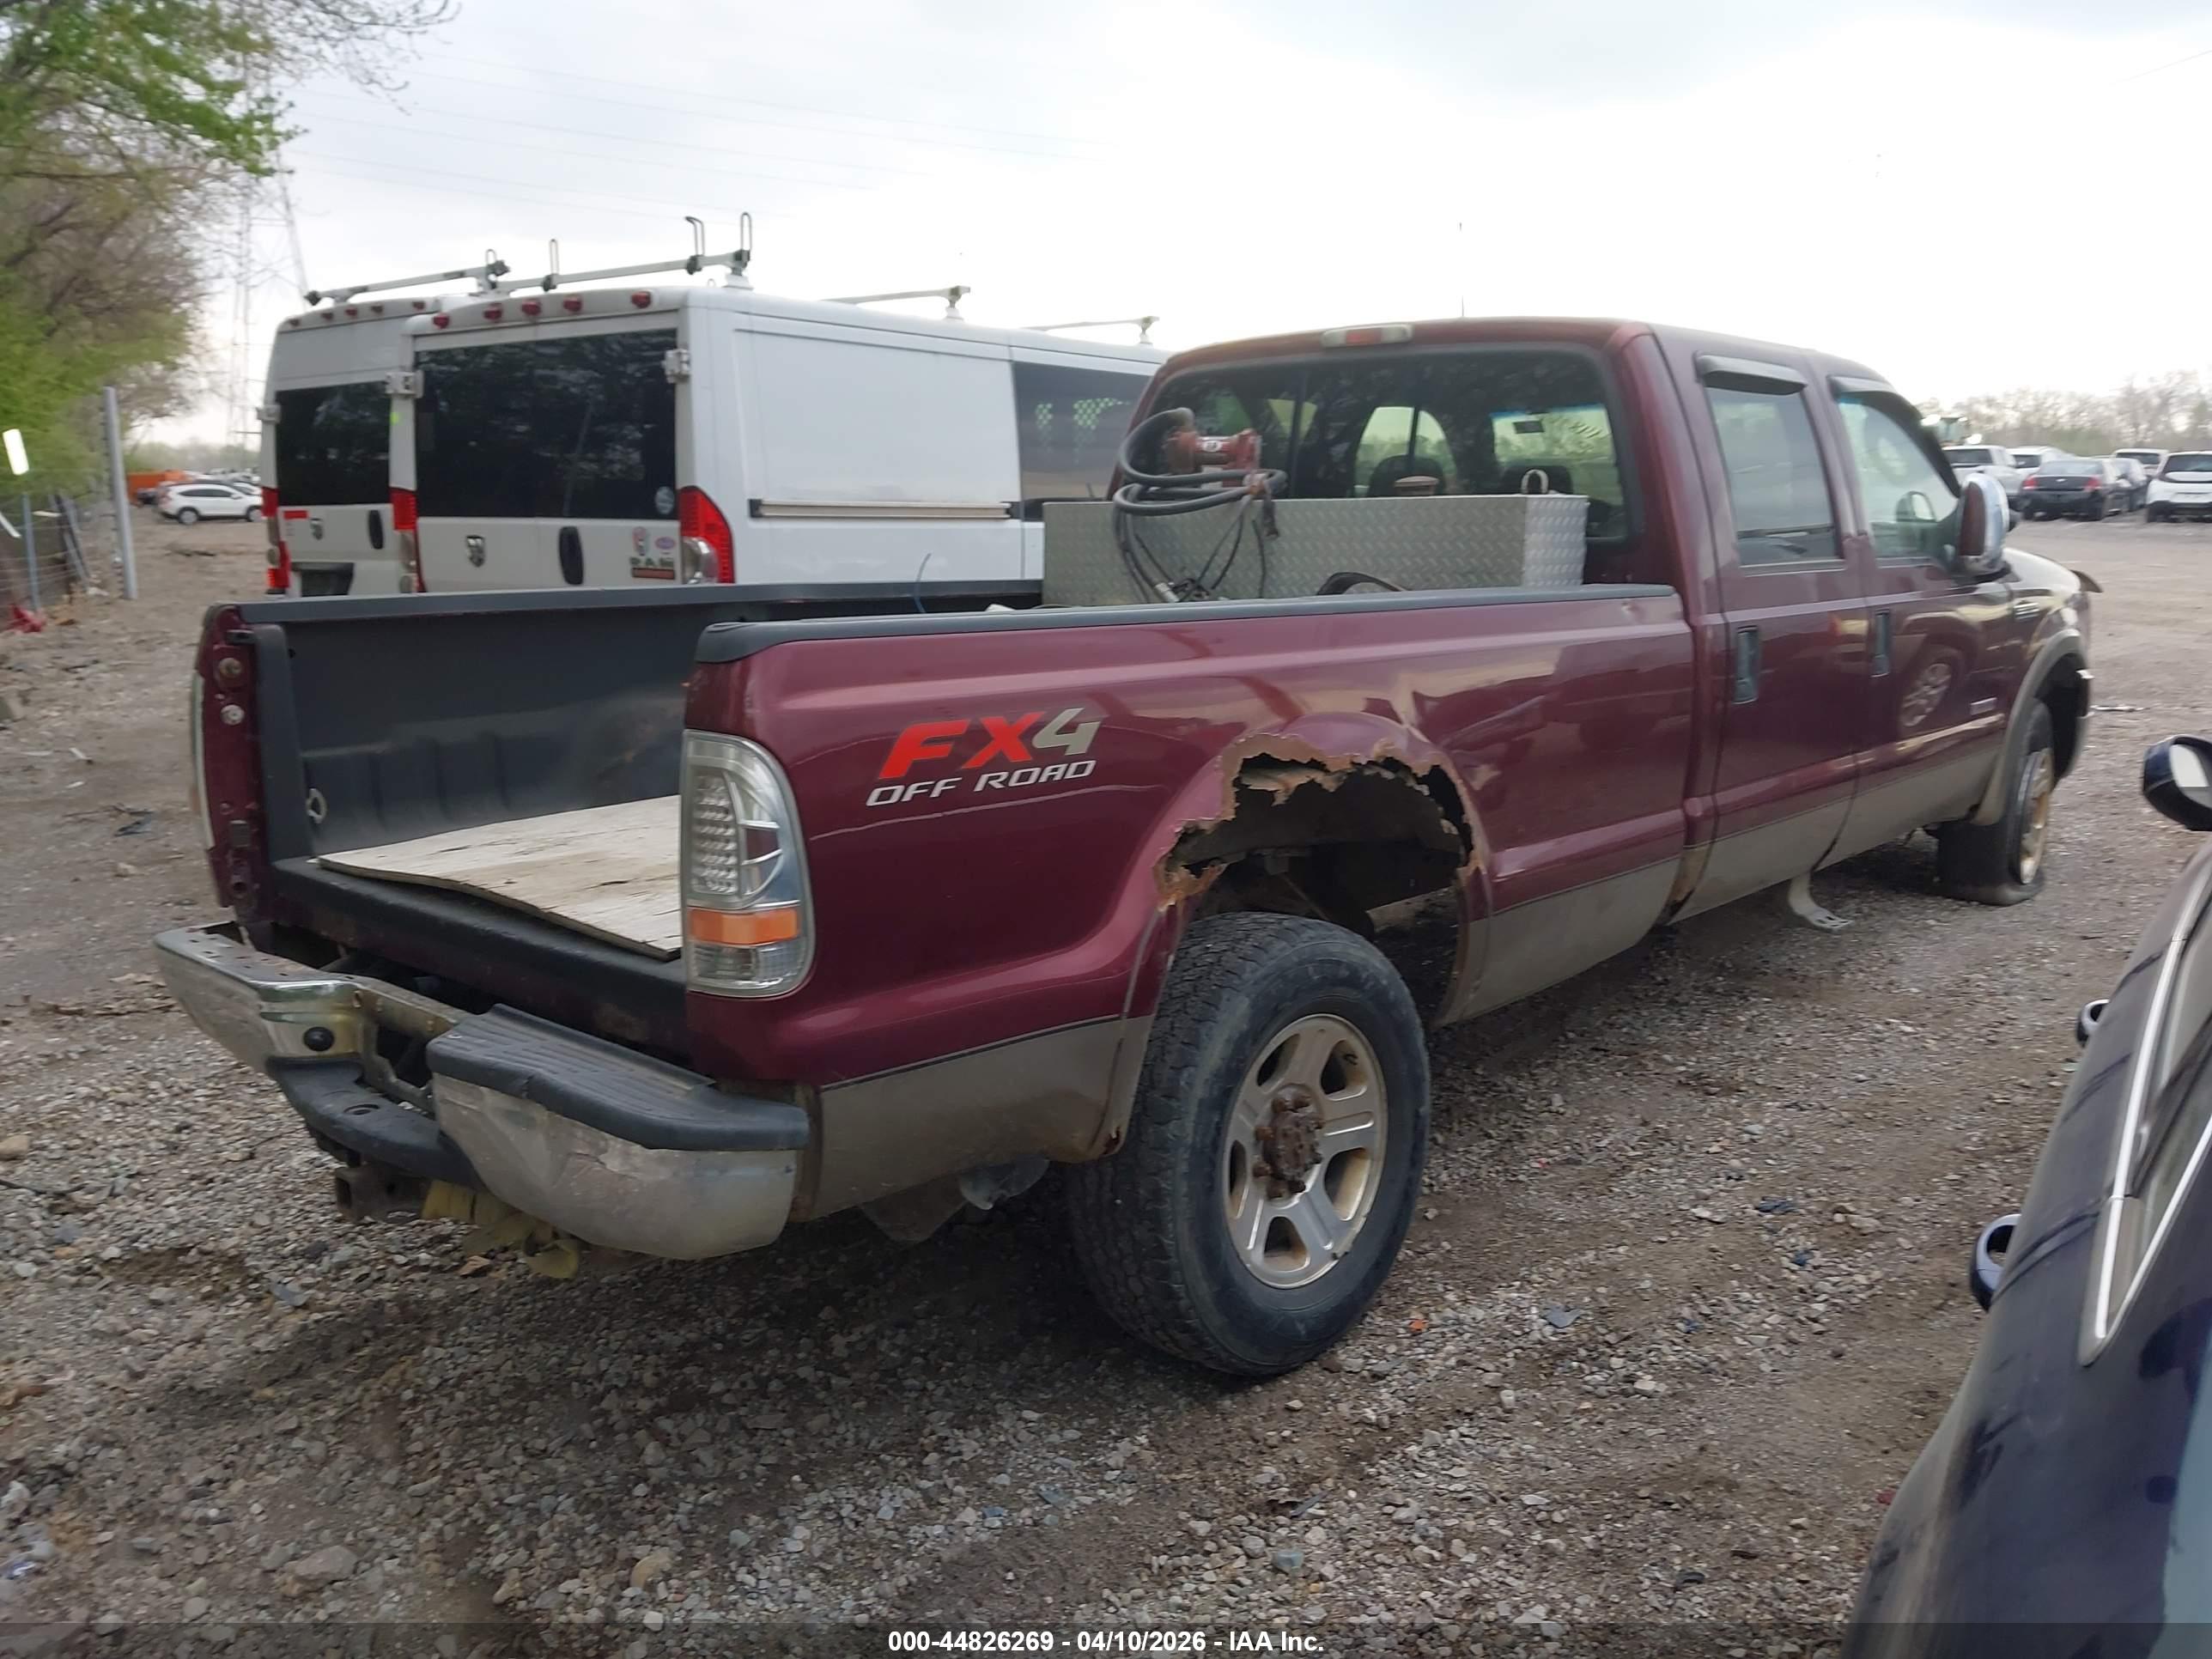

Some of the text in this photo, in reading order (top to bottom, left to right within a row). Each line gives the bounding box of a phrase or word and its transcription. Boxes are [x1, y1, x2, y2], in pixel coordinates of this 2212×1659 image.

[878, 707, 1103, 780] FX4
[866, 759, 1097, 808] OFF ROAD
